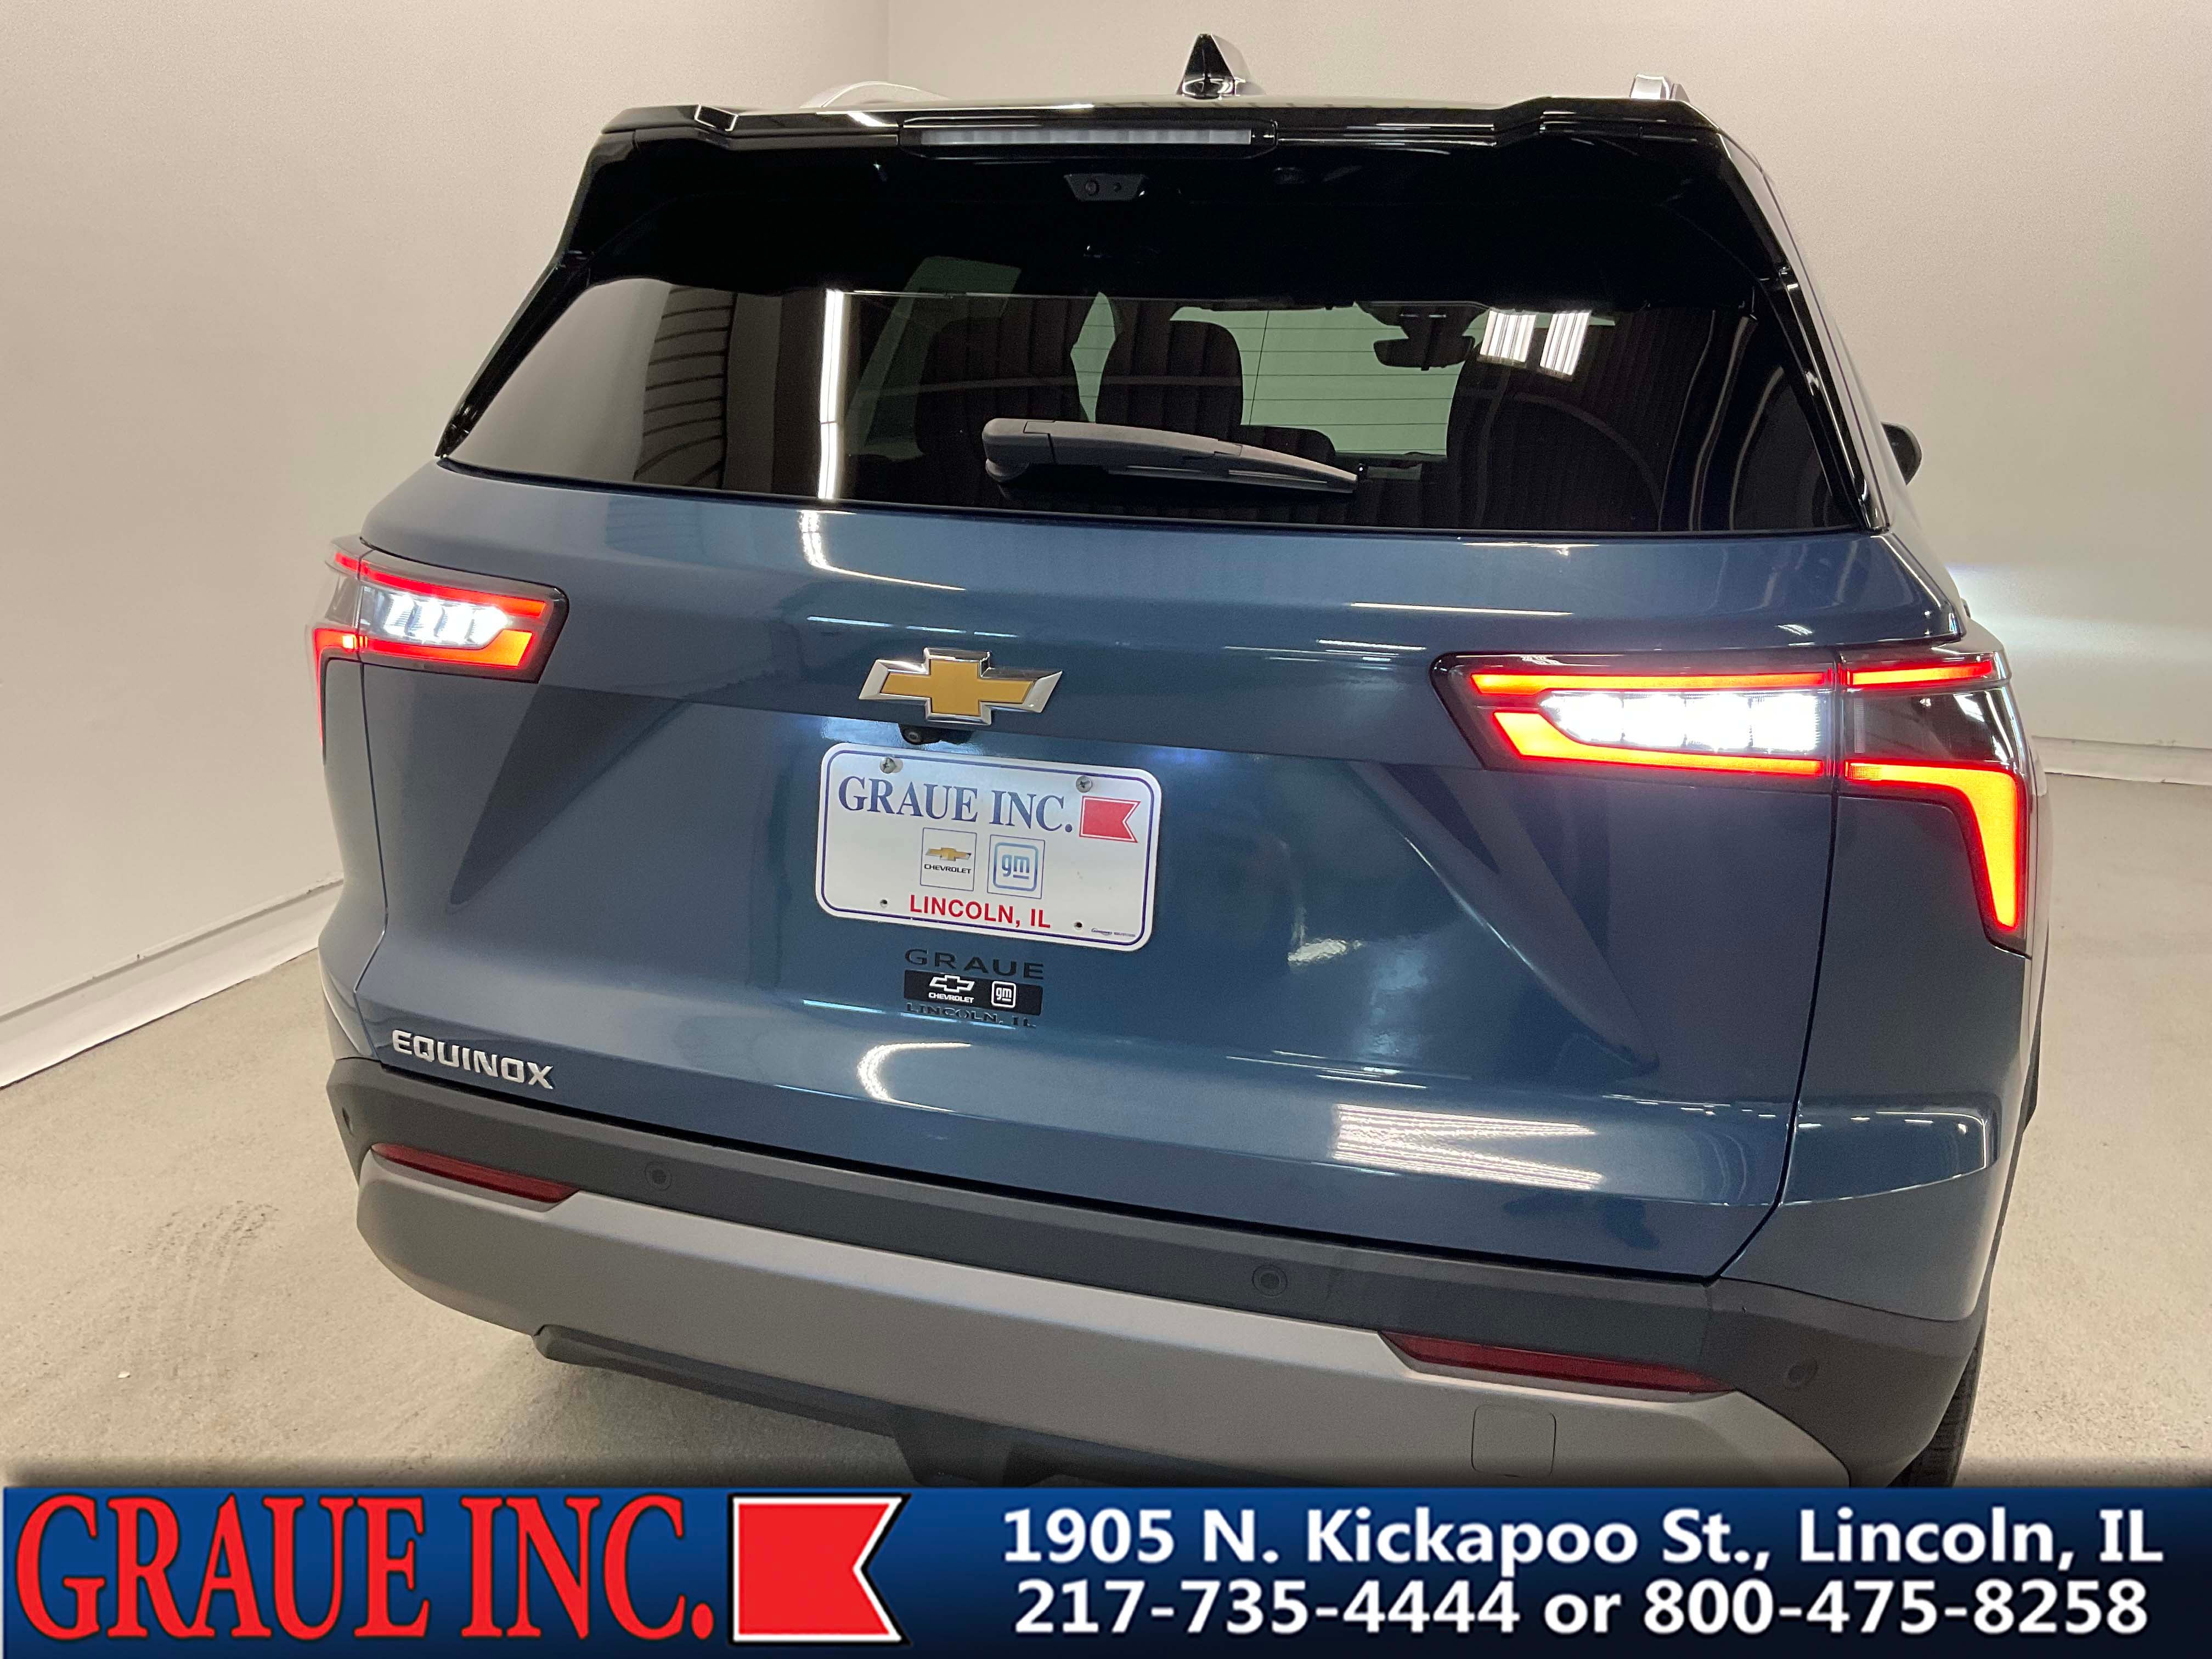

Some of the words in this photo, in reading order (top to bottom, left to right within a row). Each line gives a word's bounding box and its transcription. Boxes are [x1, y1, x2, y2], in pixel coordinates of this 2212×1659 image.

[838, 776, 978, 822] GRAUE
[989, 790, 1073, 833] INC.
[923, 863, 972, 875] CHEVROLET
[1001, 856, 1030, 880] gm
[909, 894, 1020, 928] LINCOLN,
[1030, 909, 1051, 928] IL
[905, 948, 1044, 980] GRAUE
[928, 992, 974, 1004] CHEVROLET
[995, 986, 1012, 1001] gm
[392, 1029, 554, 1090] EQUINOX
